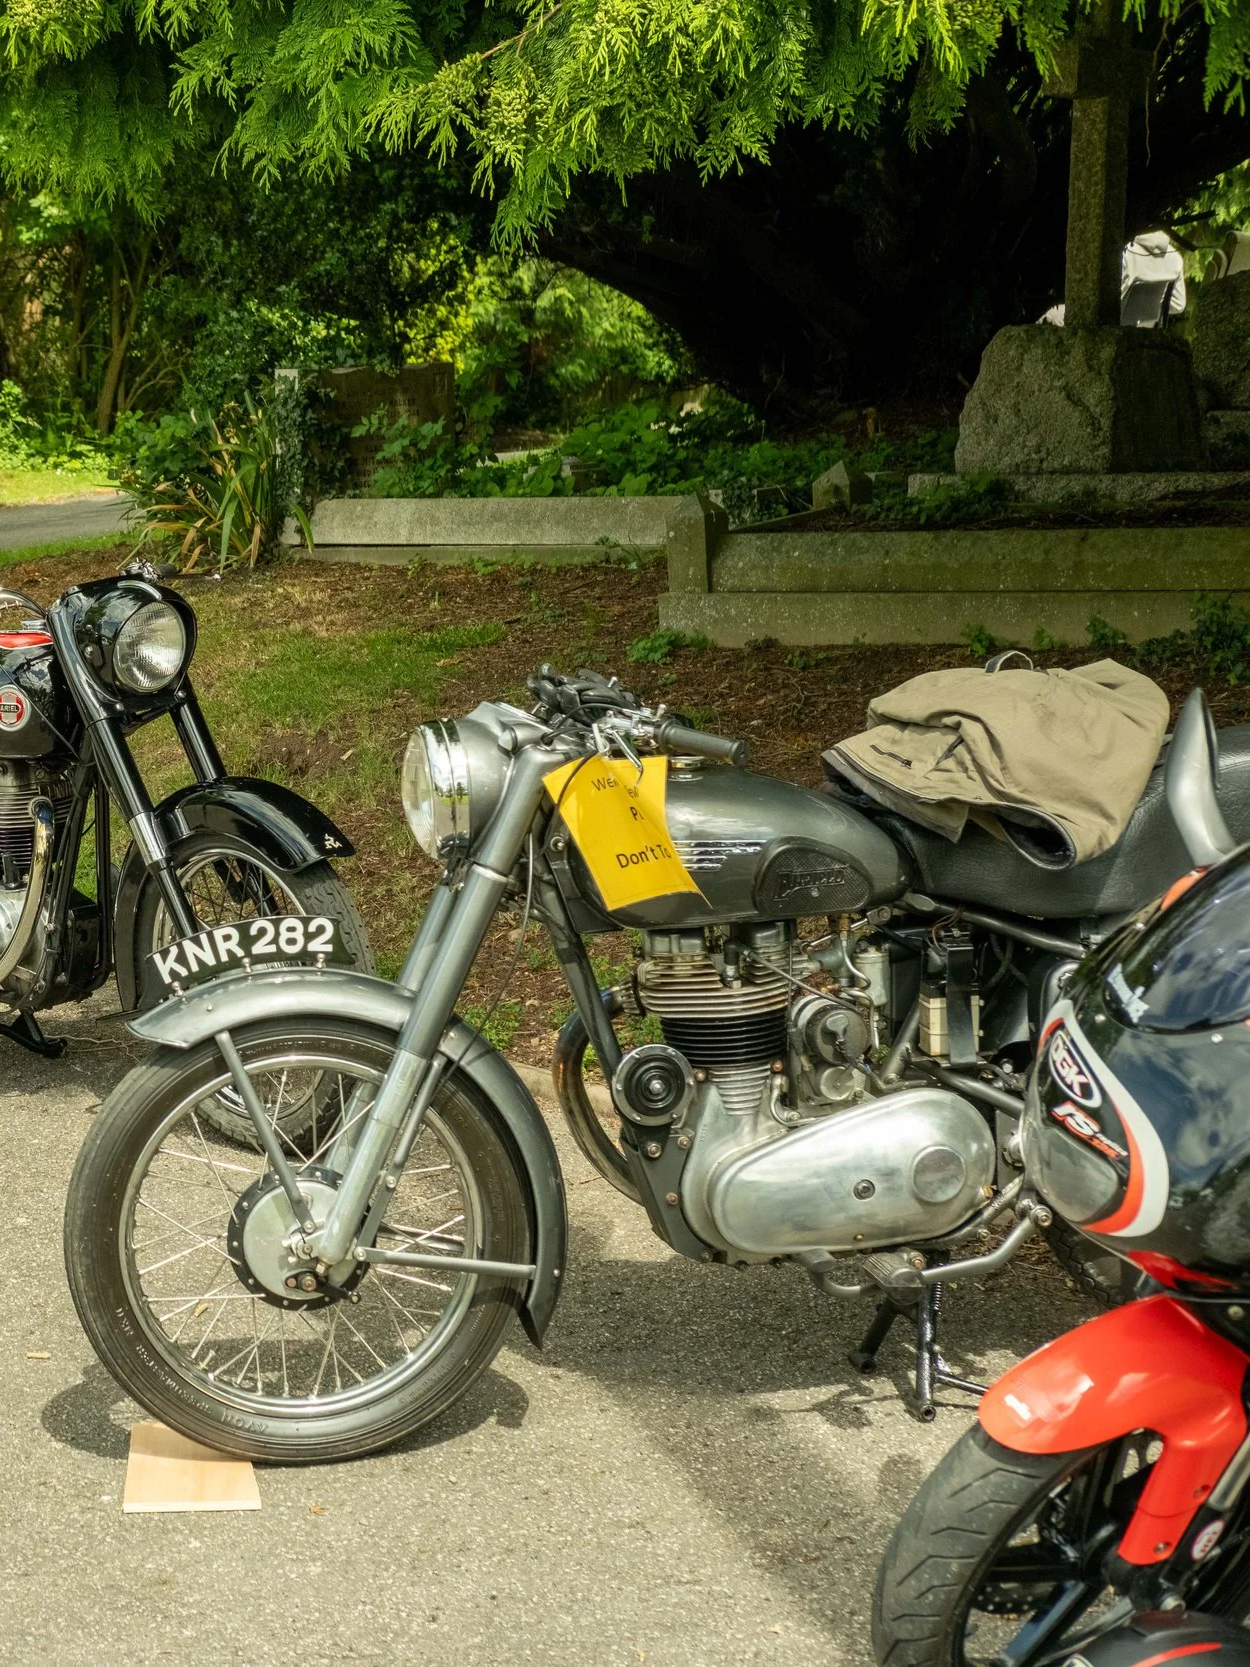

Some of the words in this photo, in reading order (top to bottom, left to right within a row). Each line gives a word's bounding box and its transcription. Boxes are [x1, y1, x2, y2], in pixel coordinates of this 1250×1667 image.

[0, 704, 19, 712] ARIEL
[615, 845, 659, 869] Don't
[152, 926, 245, 985] KNR
[250, 918, 334, 954] 282
[220, 1407, 270, 1435] AVON
